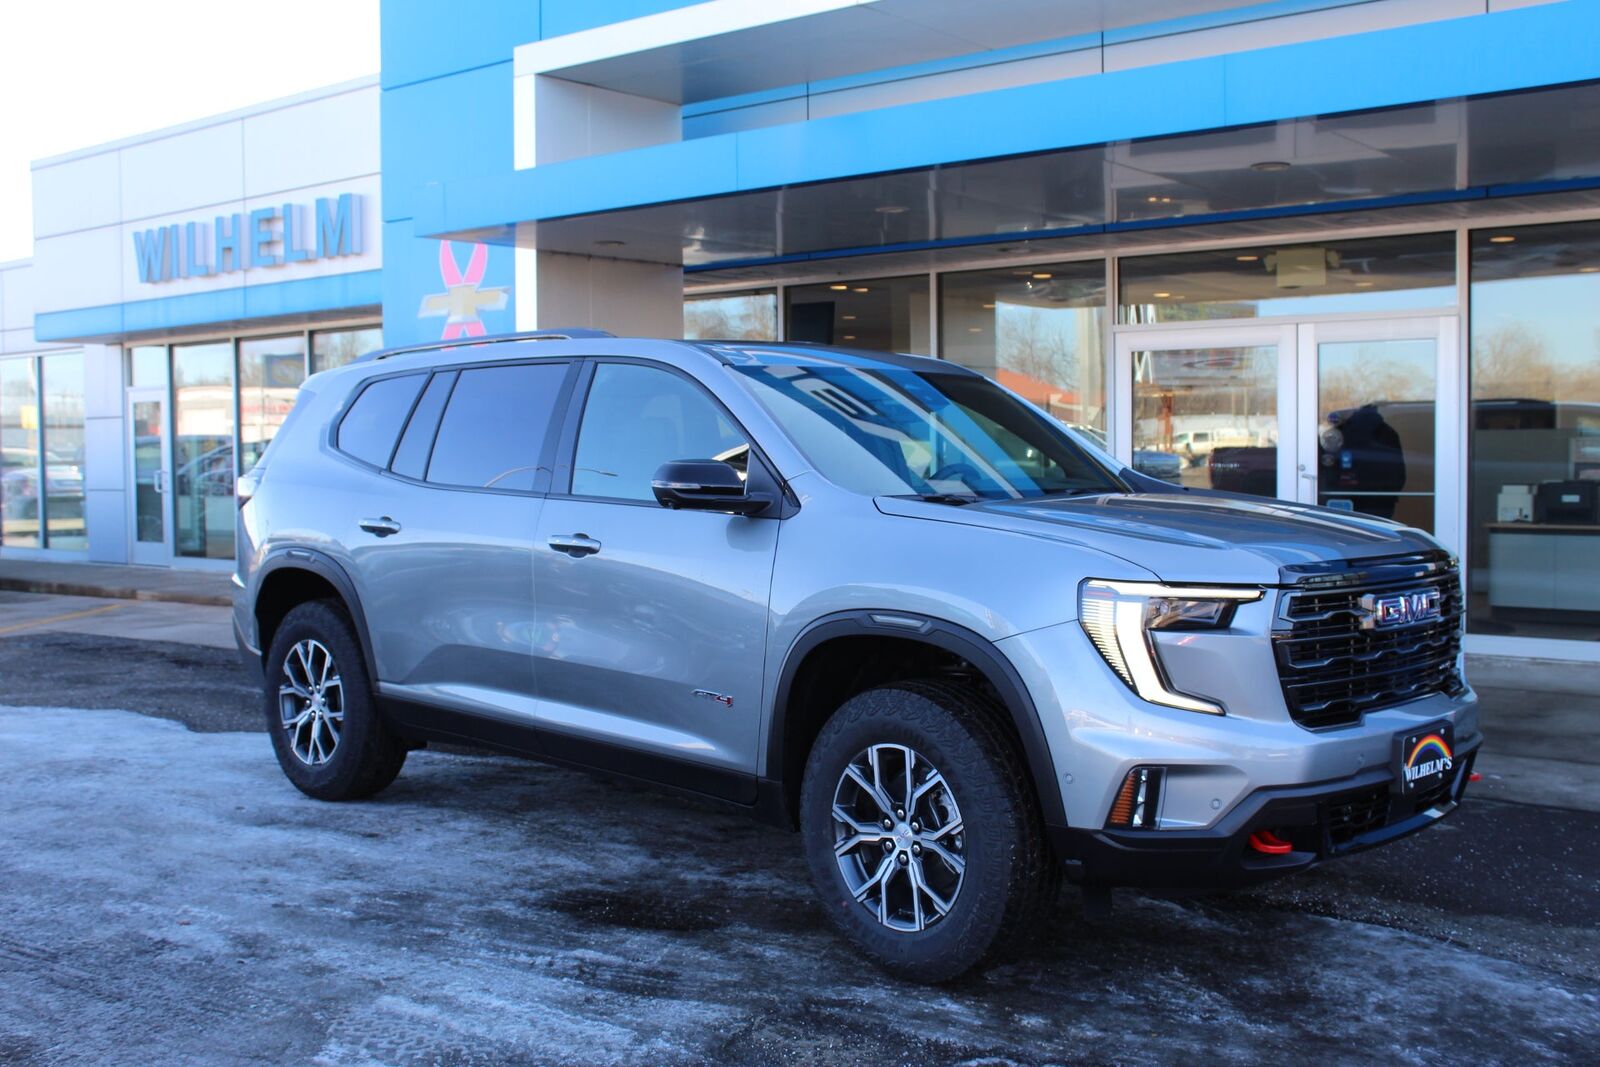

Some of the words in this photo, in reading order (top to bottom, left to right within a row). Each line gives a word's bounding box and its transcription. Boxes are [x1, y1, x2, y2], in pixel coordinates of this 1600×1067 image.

[133, 193, 362, 283] WILHELM
[1376, 591, 1441, 624] GMC
[1404, 756, 1452, 782] WILHELM'S
